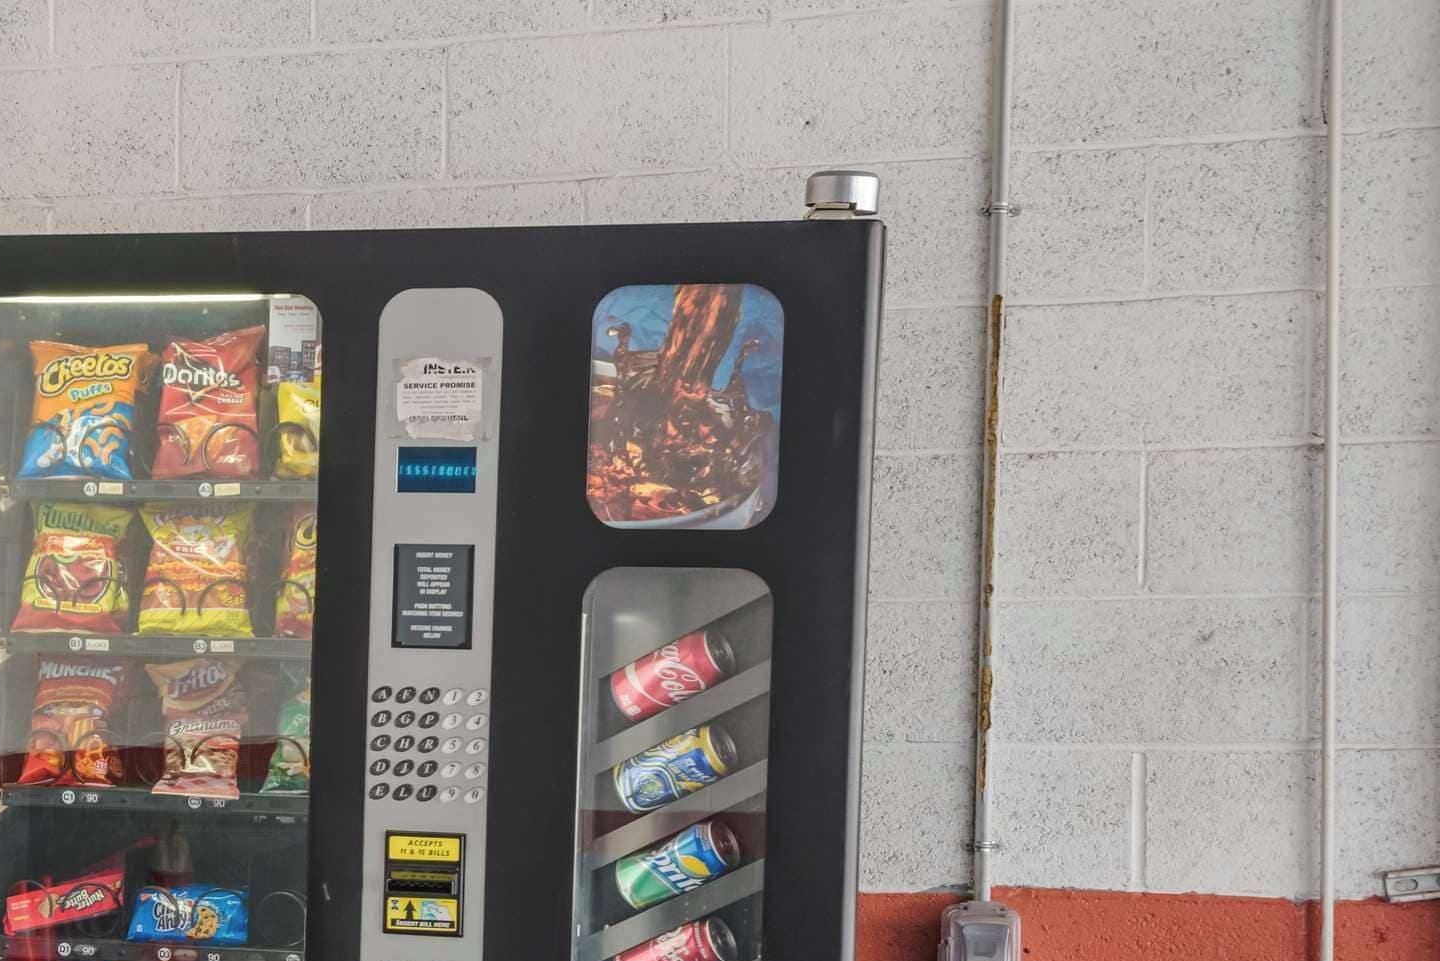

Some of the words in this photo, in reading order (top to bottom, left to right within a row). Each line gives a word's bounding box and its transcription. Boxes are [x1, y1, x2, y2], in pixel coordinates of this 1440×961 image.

[40, 353, 134, 397] Cheetos
[163, 363, 240, 387] Doritos
[440, 381, 476, 389] PROMISE
[85, 484, 97, 494] A1
[378, 688, 387, 699] A
[402, 689, 411, 700] F
[424, 690, 436, 701] N
[452, 690, 457, 701] 1
[475, 691, 482, 702] 2
[378, 713, 387, 723] B
[400, 714, 410, 724] G
[425, 715, 434, 725] P
[448, 715, 457, 725] 3
[474, 716, 482, 726] 4
[376, 737, 386, 748] C
[399, 738, 410, 749] H
[424, 739, 434, 749] R
[449, 739, 457, 750] 5
[473, 741, 481, 751] 6
[375, 761, 386, 772] D
[399, 762, 409, 774] J
[423, 763, 433, 774] T
[449, 764, 456, 774] 7
[472, 765, 480, 775] 8
[375, 785, 385, 796] E
[399, 786, 408, 797] L
[422, 787, 433, 798] U
[448, 789, 456, 798] 9
[86, 793, 98, 803] 90
[213, 799, 226, 808] 90
[408, 839, 443, 847] ACCEPTS
[428, 849, 450, 857] BILLS
[59, 944, 70, 954] D1
[83, 946, 95, 956] 90
[159, 950, 170, 960] D3
